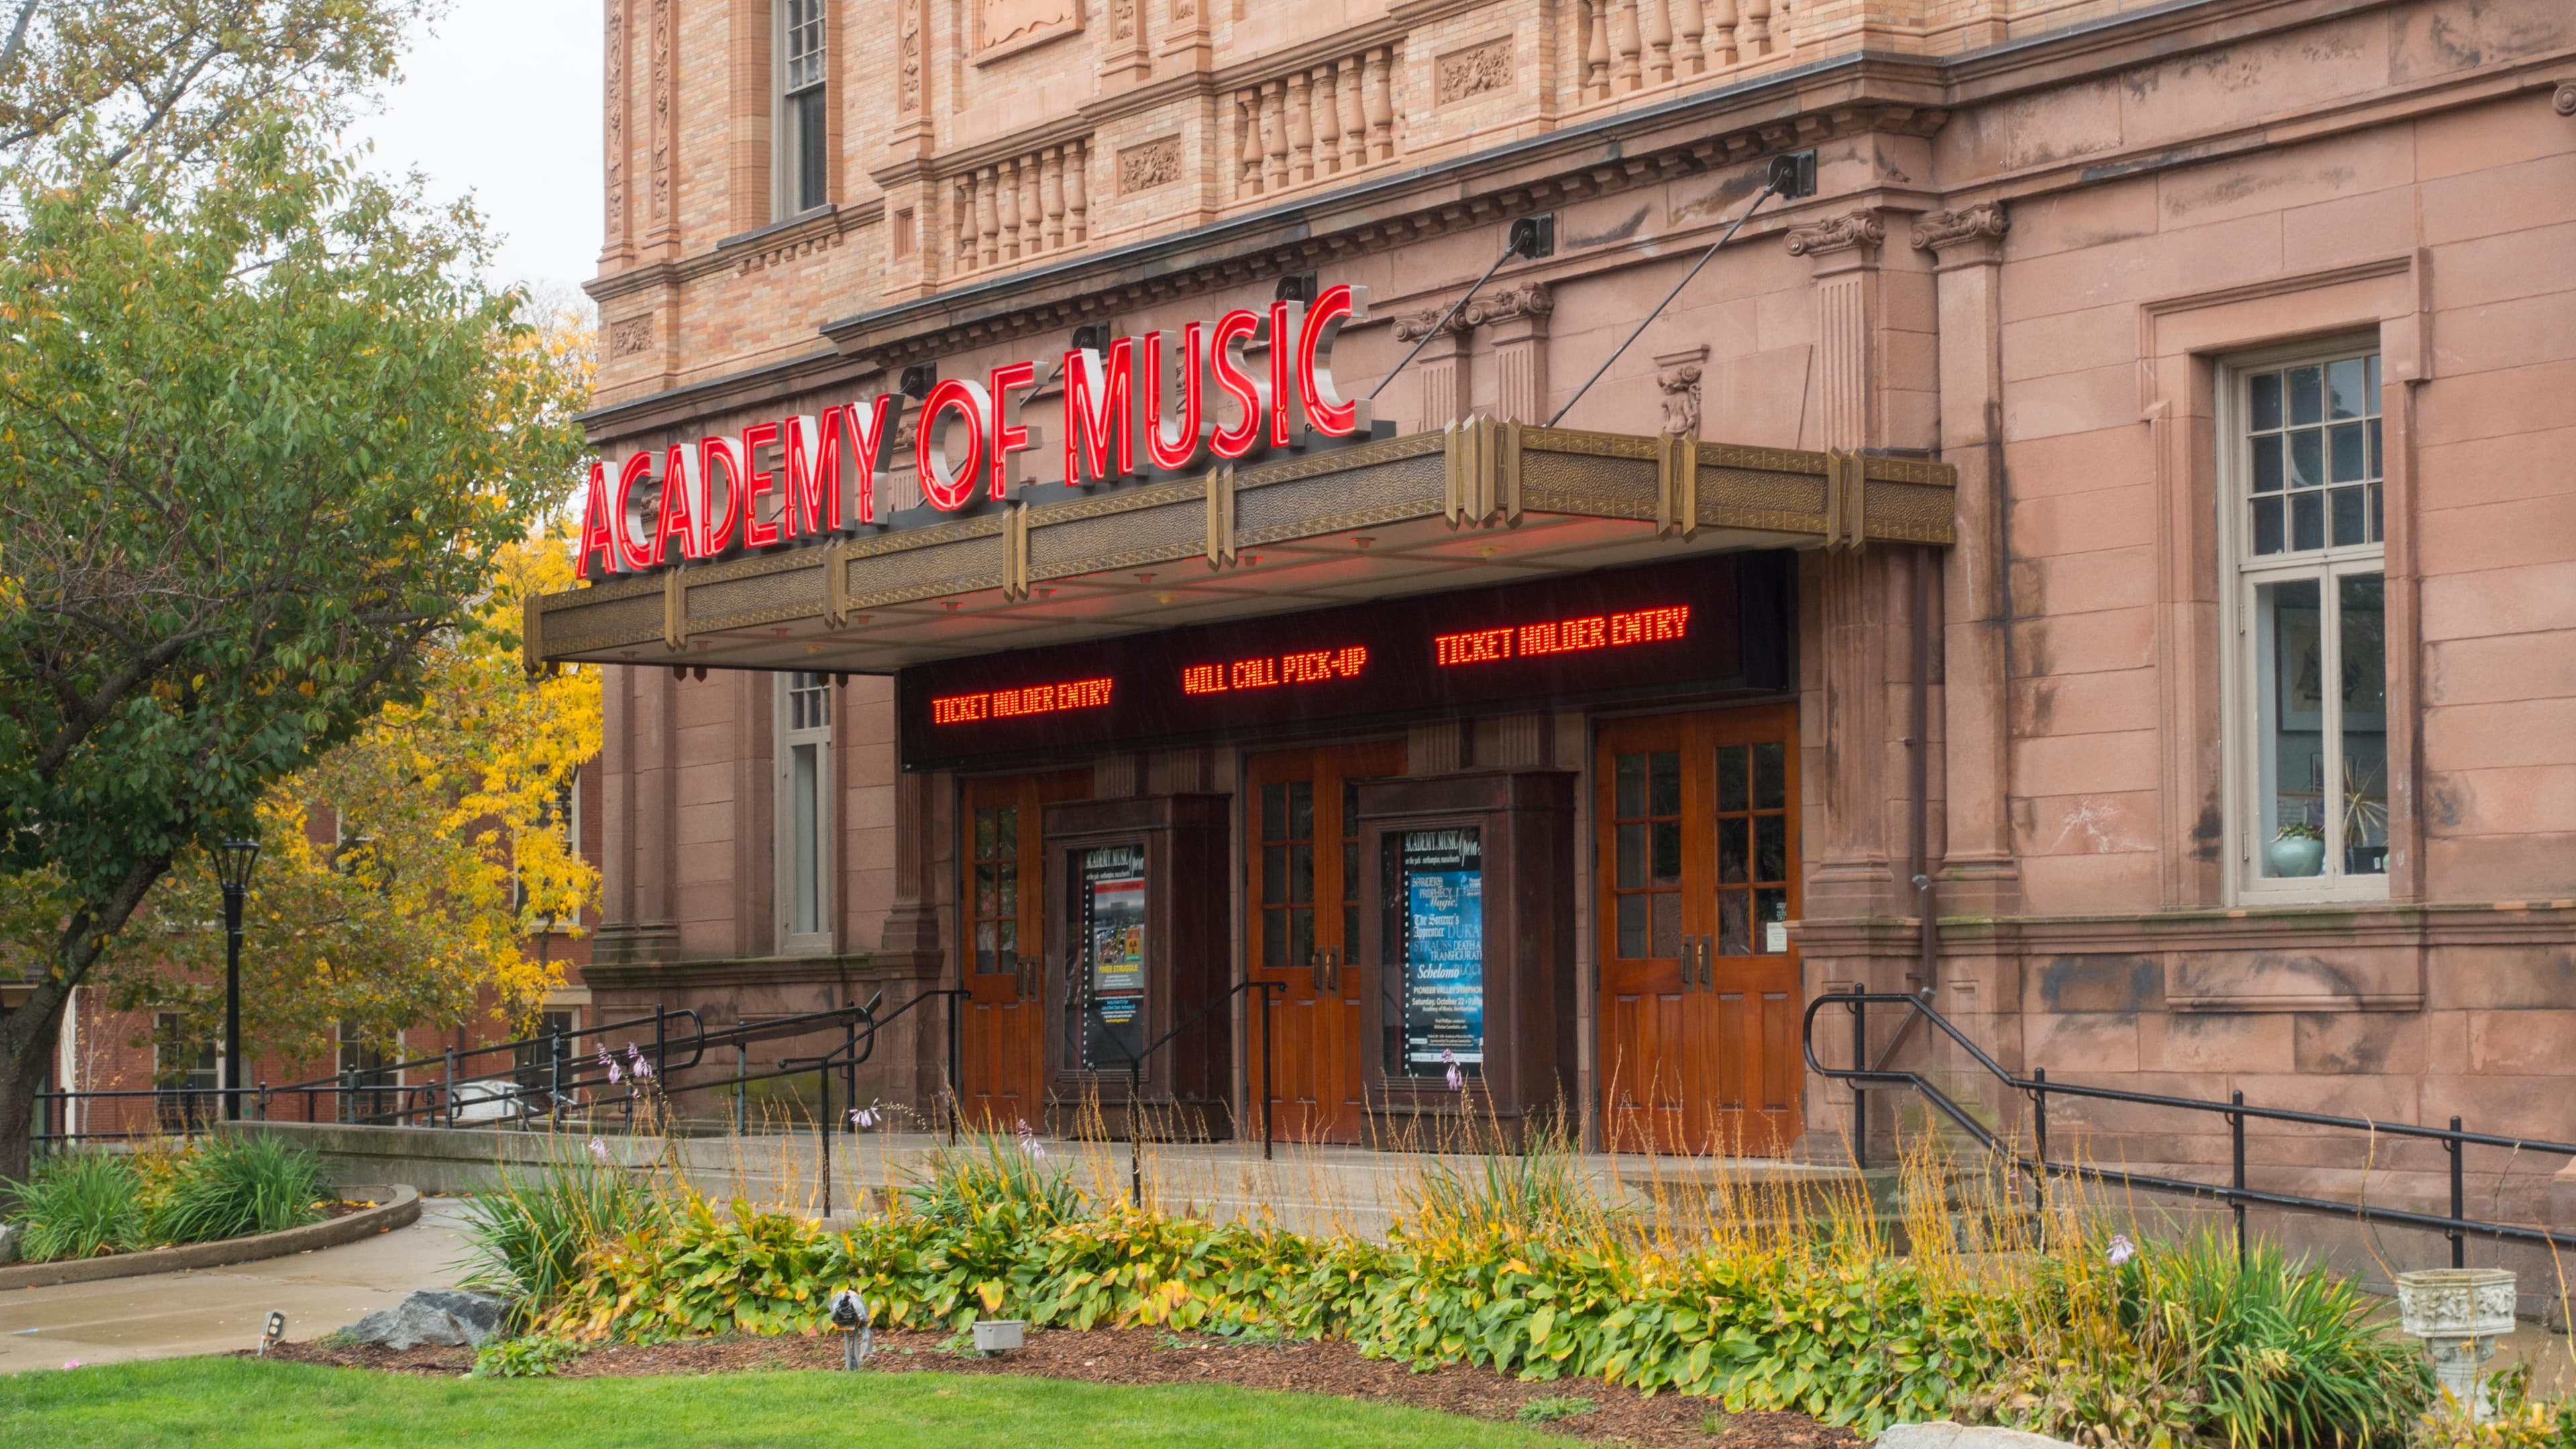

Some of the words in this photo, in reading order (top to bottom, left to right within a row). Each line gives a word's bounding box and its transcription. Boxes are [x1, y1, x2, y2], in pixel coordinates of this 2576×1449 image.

[576, 393, 901, 580] ACADEMY
[915, 360, 1048, 512] OF
[1064, 284, 1367, 487] MUSIC
[1436, 627, 1514, 665] TICKET
[1519, 616, 1606, 656] HOLDER
[1610, 605, 1688, 645] ENTRY
[1184, 663, 1228, 694] WILL
[1232, 657, 1279, 688] CALL
[1282, 646, 1366, 683] PICK-UP
[932, 692, 989, 723] TICKET
[991, 685, 1055, 716] HOLDER
[1057, 678, 1112, 709] ENTRY
[1405, 832, 1436, 852] ACADEMY
[1438, 830, 1458, 851] MUSIC
[1447, 924, 1482, 939] DUKA
[1430, 951, 1483, 961] TRANSFIGURATI
[1456, 985, 1483, 994] SYMPHON
